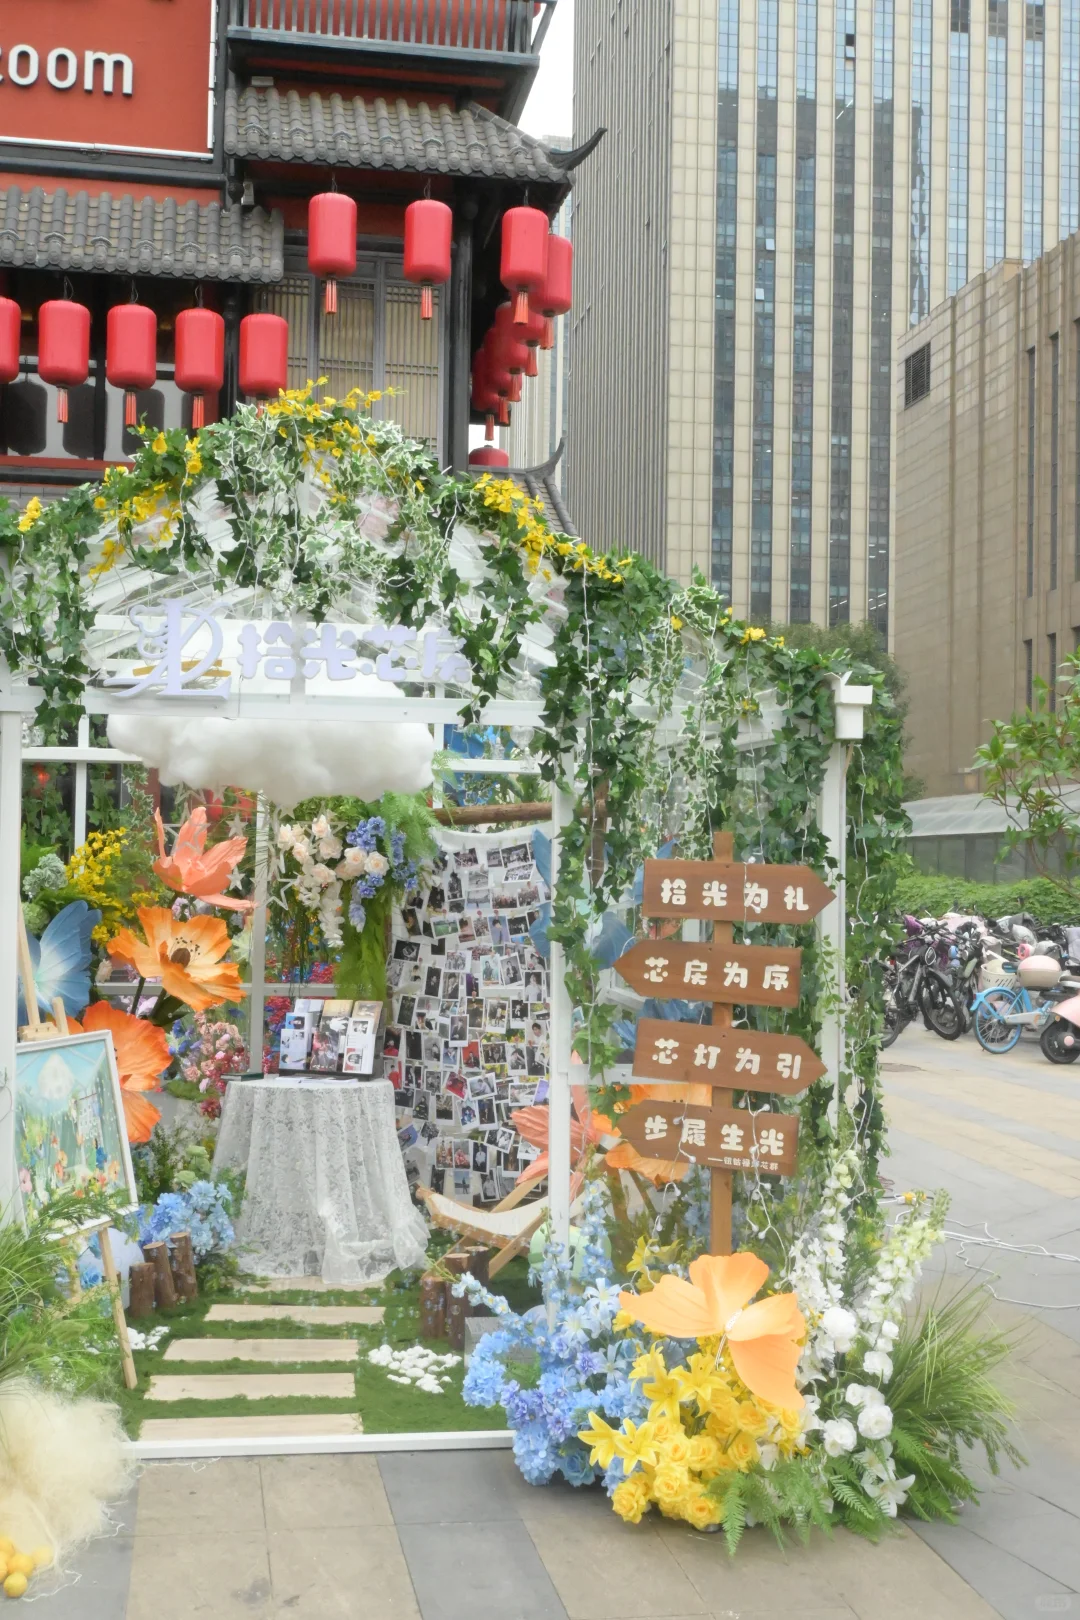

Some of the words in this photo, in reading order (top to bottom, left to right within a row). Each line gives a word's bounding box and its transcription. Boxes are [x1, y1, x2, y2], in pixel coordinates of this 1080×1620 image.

[0, 44, 133, 95] oom
[661, 878, 809, 911] 拾光为礼
[643, 956, 790, 991] 芯房为序
[652, 1038, 802, 1080] 芯灯为引
[644, 1114, 785, 1156] 步履生光
